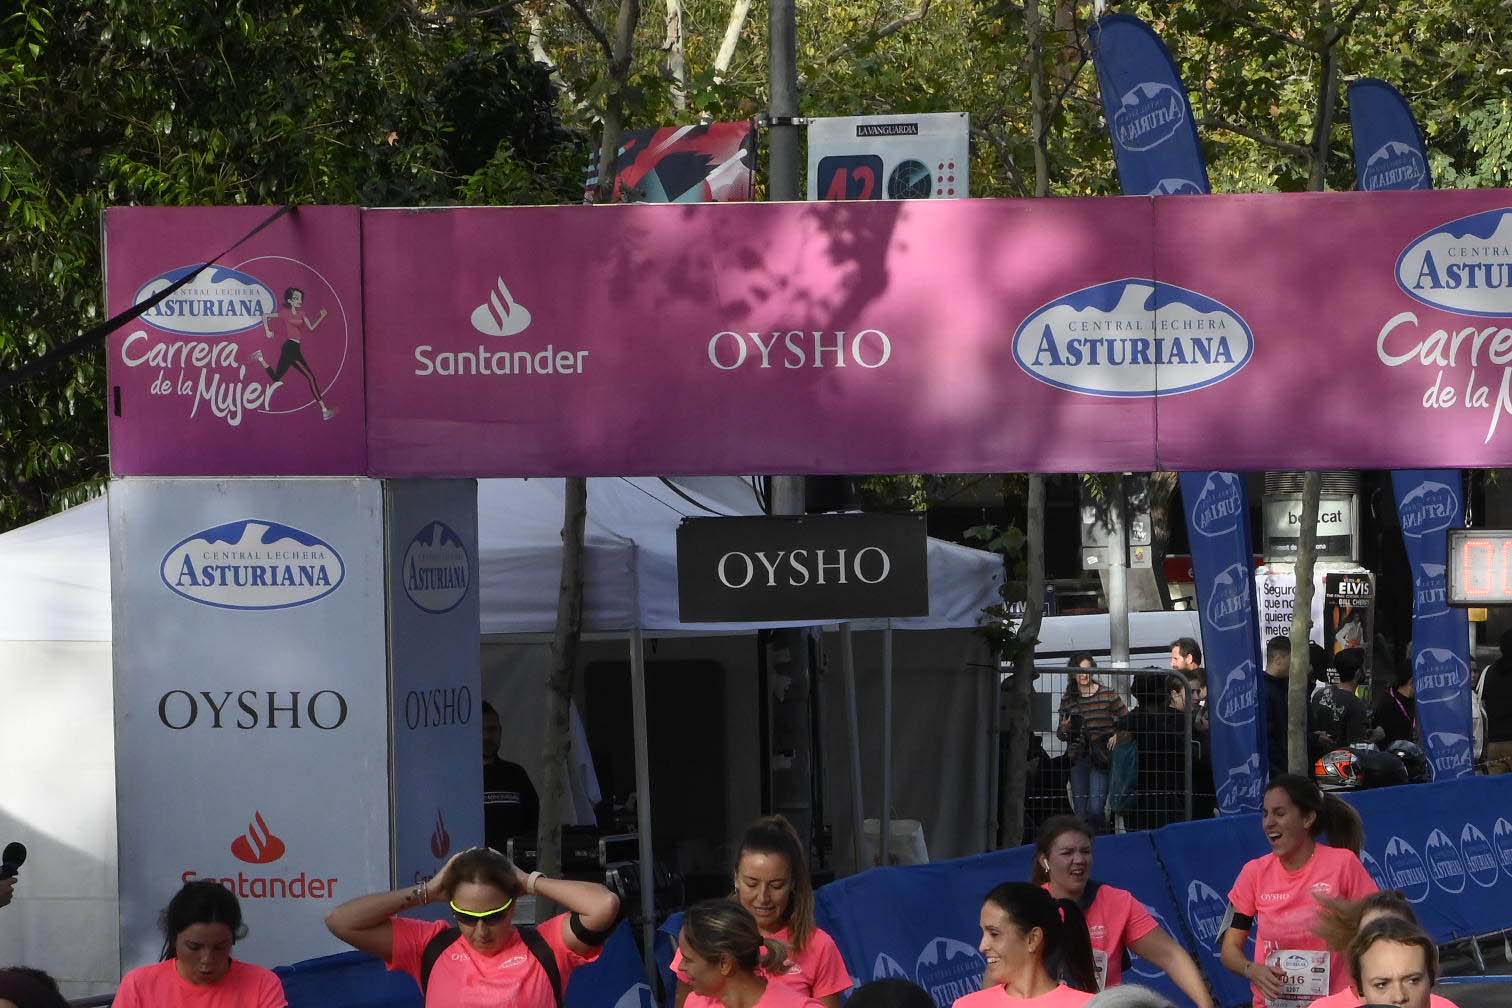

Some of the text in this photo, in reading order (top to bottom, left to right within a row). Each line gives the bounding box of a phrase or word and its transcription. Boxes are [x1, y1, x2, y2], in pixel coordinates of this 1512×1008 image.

[146, 289, 264, 317] ASTURIANA
[1068, 319, 1228, 332] CENTRAL LECHERA
[121, 330, 239, 368] Carrera
[414, 345, 588, 375] Santander
[706, 329, 892, 370] OYSHO
[1031, 323, 1235, 366] ASTURIANA
[151, 364, 284, 426] de la Mujer
[1422, 370, 1456, 409] de
[1465, 370, 1490, 409] la
[1289, 509, 1342, 525] b.cat
[175, 553, 332, 587] ASTURIANA
[204, 551, 326, 560] CENTRAL LECHERA
[718, 546, 891, 589] OYSHO
[408, 557, 466, 592] ASTURIANA
[1339, 582, 1369, 595] ELVIS
[1264, 600, 1280, 609] que
[158, 690, 348, 730] OYSHO
[405, 685, 472, 730] OYSHO
